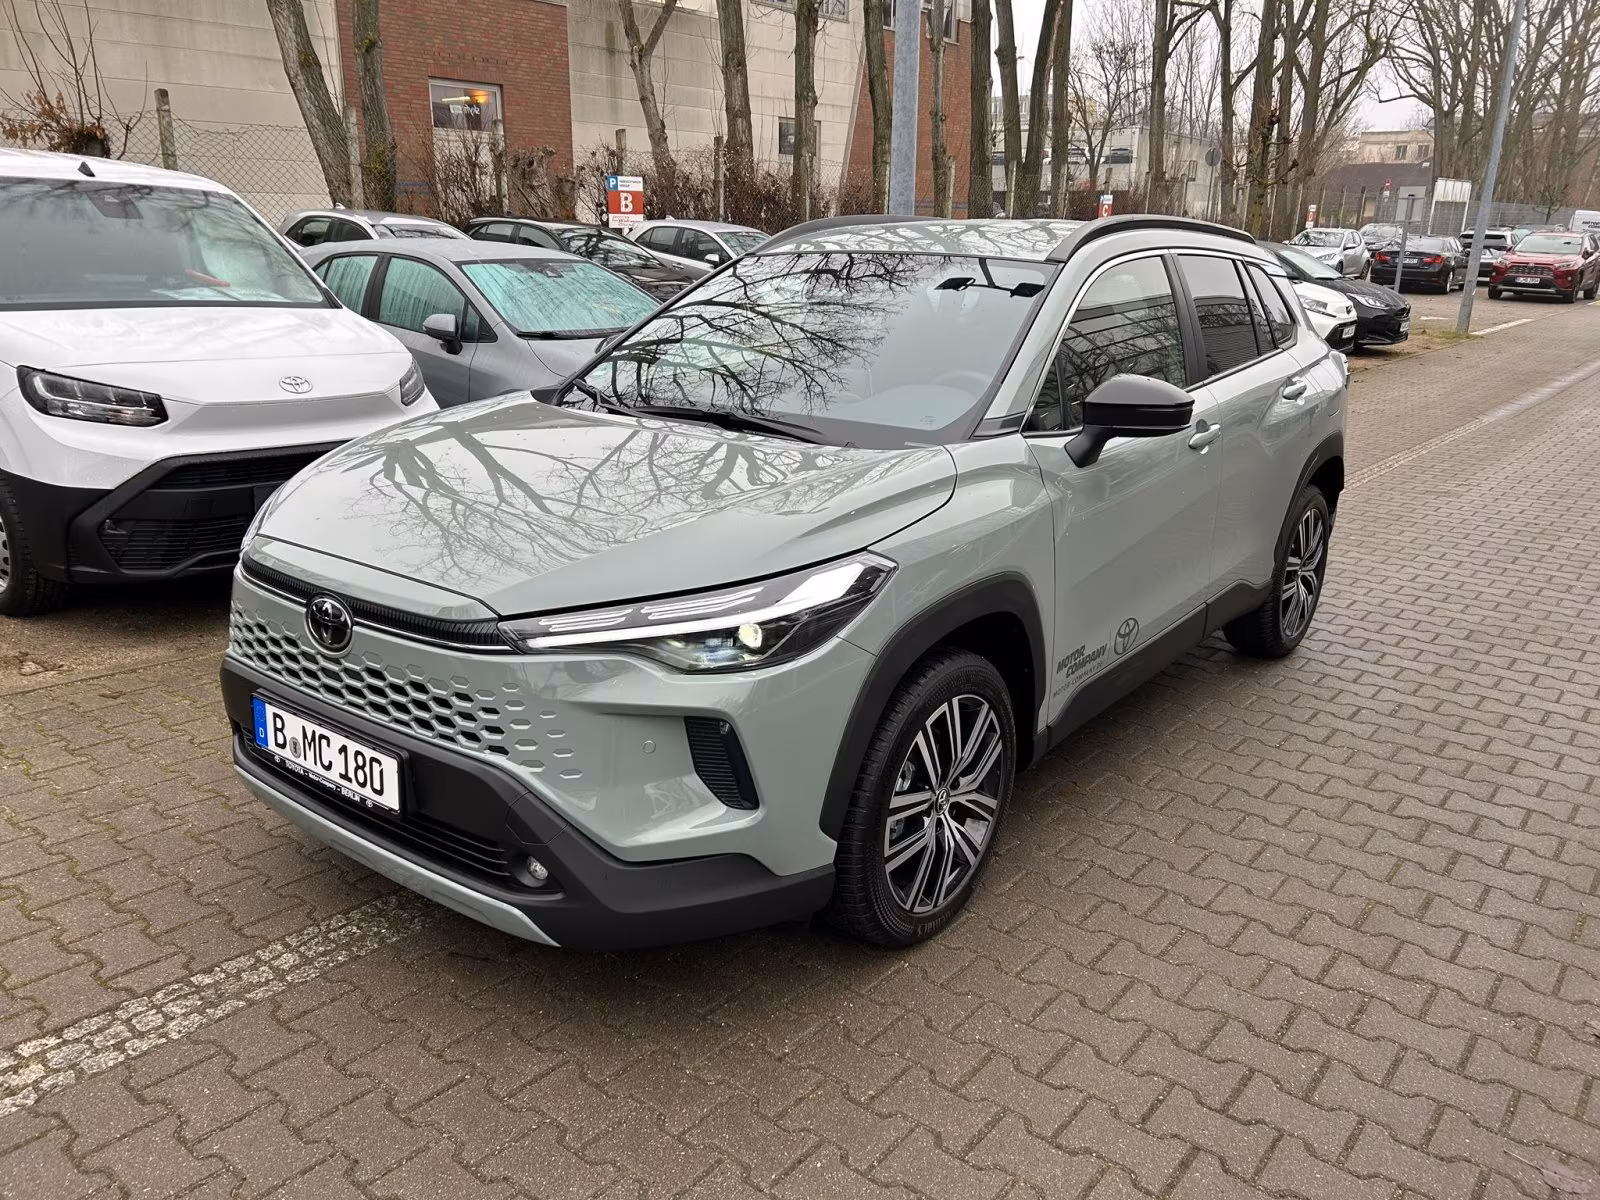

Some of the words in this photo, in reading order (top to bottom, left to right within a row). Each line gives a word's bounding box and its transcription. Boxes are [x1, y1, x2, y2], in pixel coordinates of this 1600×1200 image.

[609, 178, 616, 188] P
[619, 192, 633, 212] B
[1103, 205, 1108, 216] C
[1056, 644, 1086, 674] MOTOR
[1066, 643, 1108, 679] COMPANY
[259, 727, 265, 738] D
[273, 712, 287, 750] B
[302, 725, 333, 771] MC
[338, 743, 384, 796] 180
[285, 759, 305, 776] TOYOTA
[341, 786, 361, 803] BERLIN
